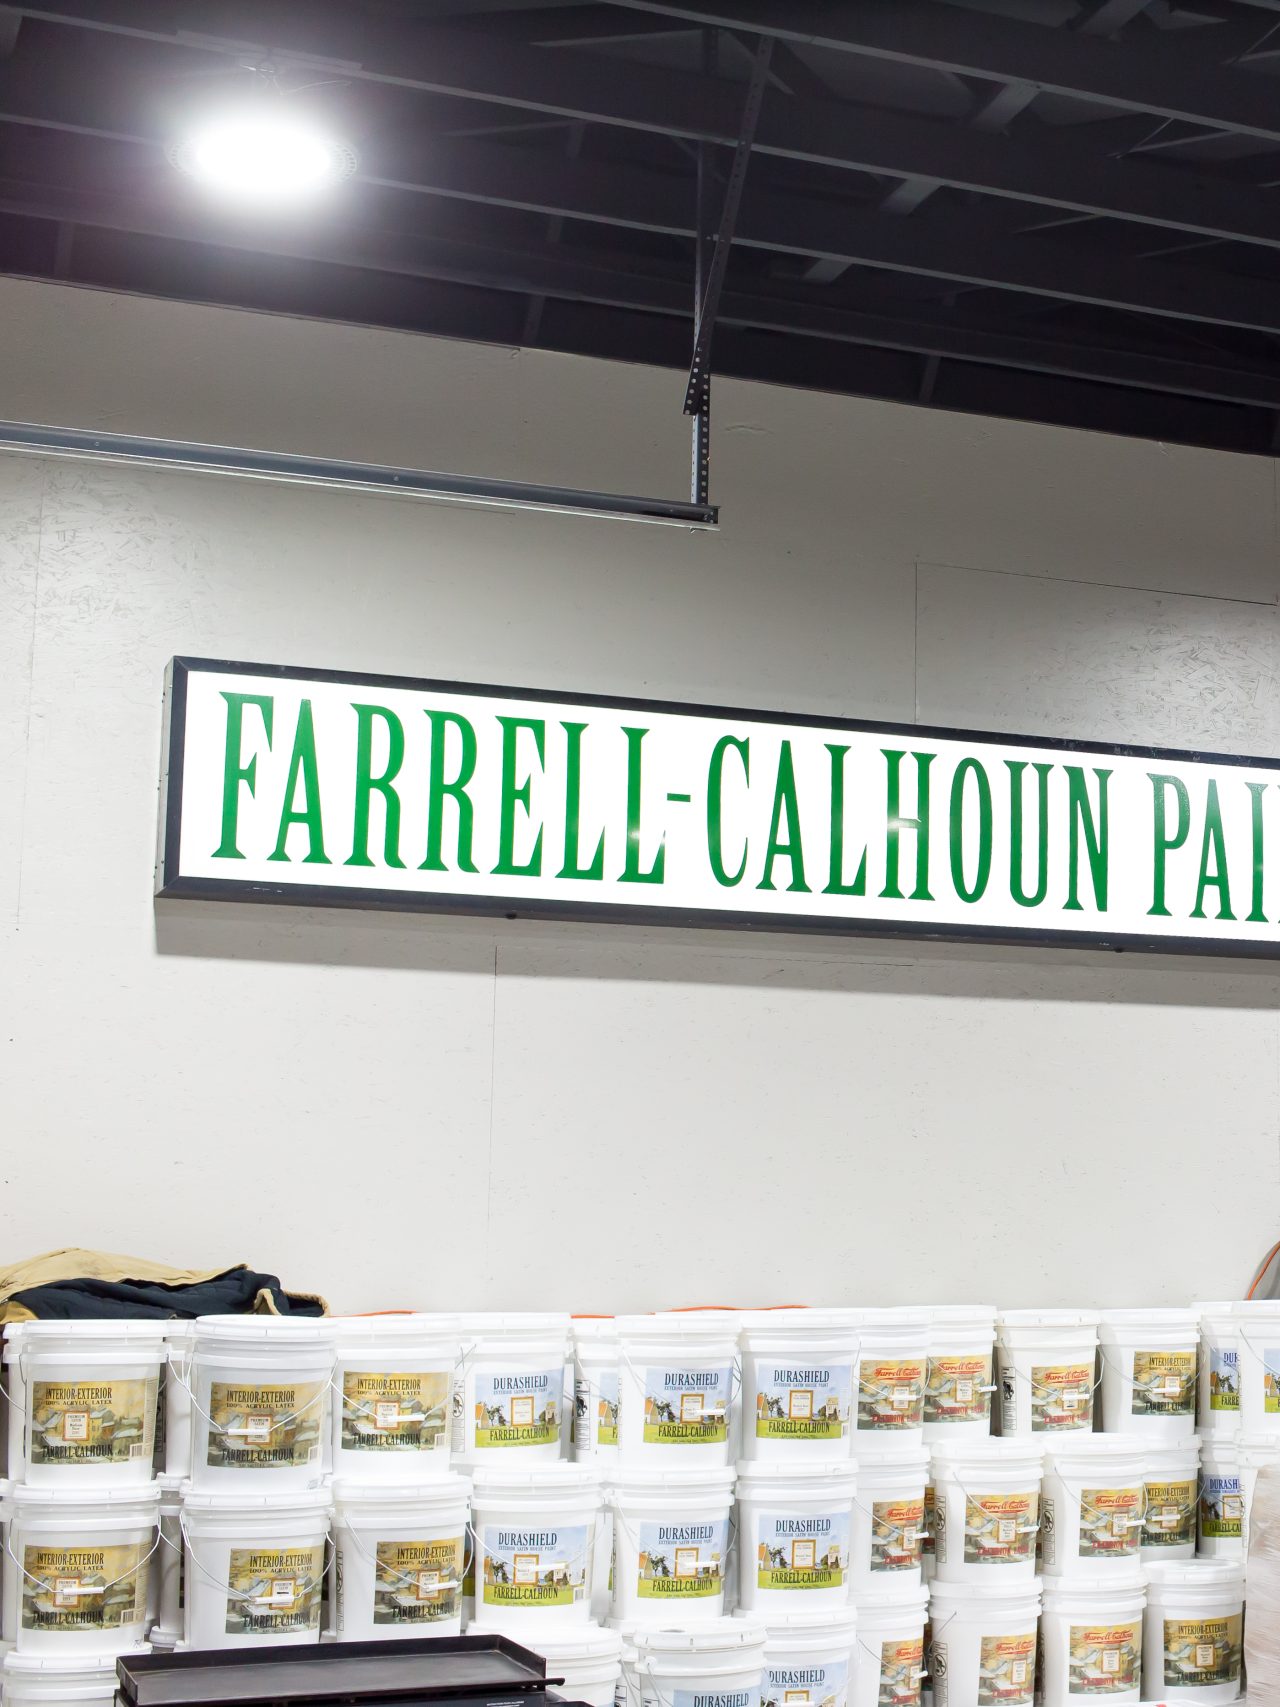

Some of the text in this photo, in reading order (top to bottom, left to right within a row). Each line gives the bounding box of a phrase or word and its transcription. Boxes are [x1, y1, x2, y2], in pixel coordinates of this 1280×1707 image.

[211, 691, 1113, 913] FARRELL-CALHOUN
[493, 1375, 548, 1390] DURASHIELD
[664, 1373, 719, 1386] DURASHIELD
[774, 1370, 830, 1383] DURASHIELD
[357, 1378, 421, 1391] INTERIOR-EXTERIOR
[45, 1388, 112, 1400] INTERIOR-EXTERIOR
[226, 1390, 295, 1403] INTERIOR-EXTERIOR
[658, 1425, 718, 1438] FARRELL-CALHOUN
[768, 1420, 830, 1434] FARRELL-CALHOUN
[490, 1428, 550, 1441] FARRELL-CALHOUN
[775, 1519, 831, 1532] DURASHIELD
[499, 1532, 557, 1546] DURASHIELD
[659, 1526, 714, 1540] DURASHIELD
[37, 1552, 104, 1566] INTERIOR-EXTERIOR
[397, 1545, 456, 1560] INTERIOR-EXTERIOR
[249, 1553, 313, 1568] INTERIOR-EXTERIOR
[771, 1571, 832, 1584] FARRELL-CALHOUN
[494, 1586, 559, 1600] FARRELL-CALHOUN
[653, 1579, 713, 1593] FARRELL-CALHOUN
[769, 1669, 825, 1684] DURASHIELD
[694, 1693, 749, 1707] DURASHIELD
